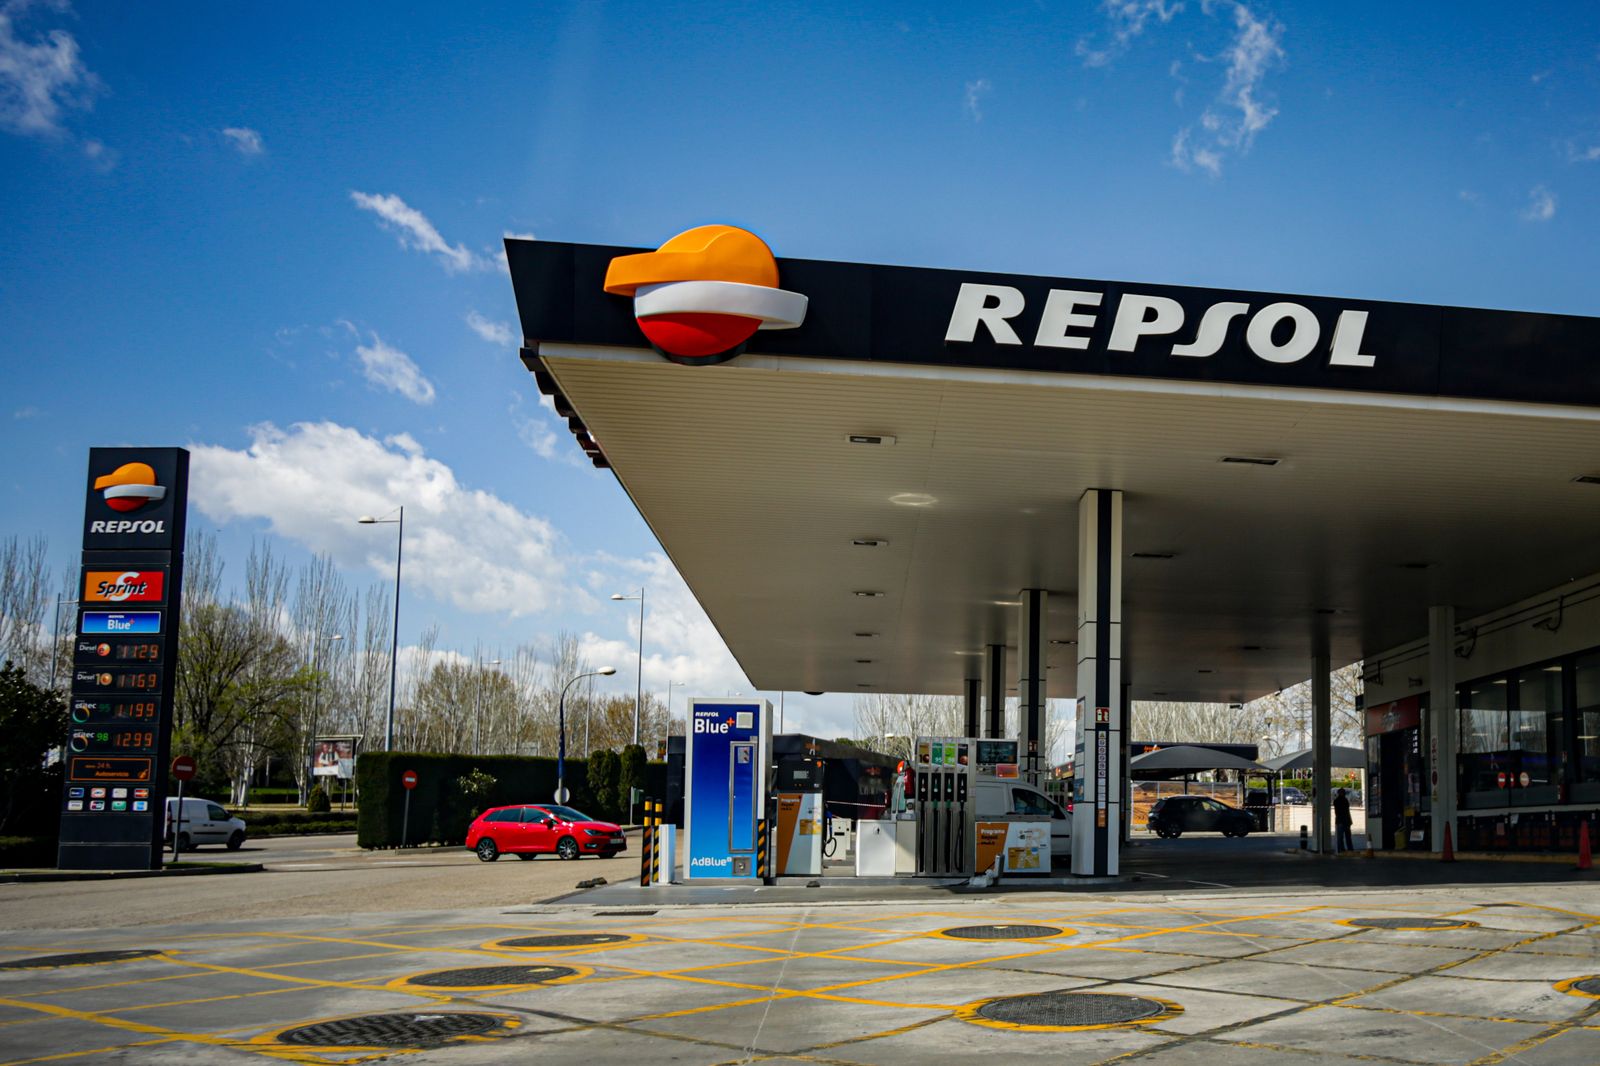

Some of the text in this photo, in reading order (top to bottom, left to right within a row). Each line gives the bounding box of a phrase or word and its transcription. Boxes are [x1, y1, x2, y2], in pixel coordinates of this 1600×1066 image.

[944, 282, 1377, 368] REPSOL
[90, 520, 165, 534] REPSOL
[96, 581, 148, 598] Sprint
[96, 732, 109, 742] 98
